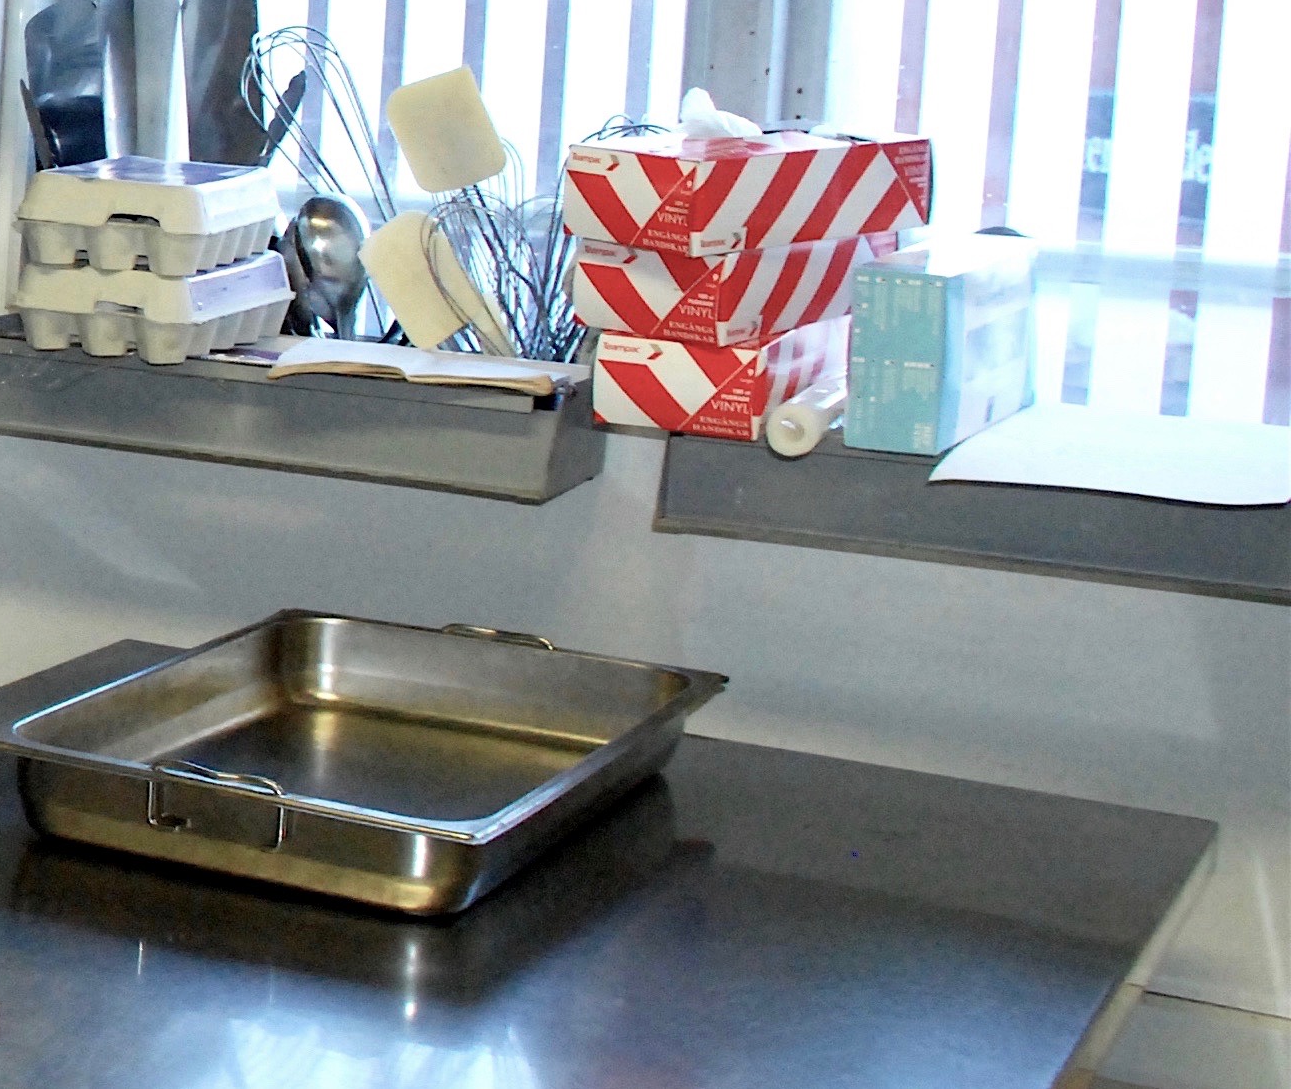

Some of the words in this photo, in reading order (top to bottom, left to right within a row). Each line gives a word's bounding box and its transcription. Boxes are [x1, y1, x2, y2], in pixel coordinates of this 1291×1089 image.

[656, 211, 689, 228] VINYL
[678, 303, 715, 321] VINYL
[668, 320, 715, 335] ENGÅNGS
[663, 328, 716, 344] HANDSKAR
[711, 399, 750, 415] VINYL
[699, 415, 750, 428] ENGÅNGS
[692, 424, 751, 438] HANDSKAR
